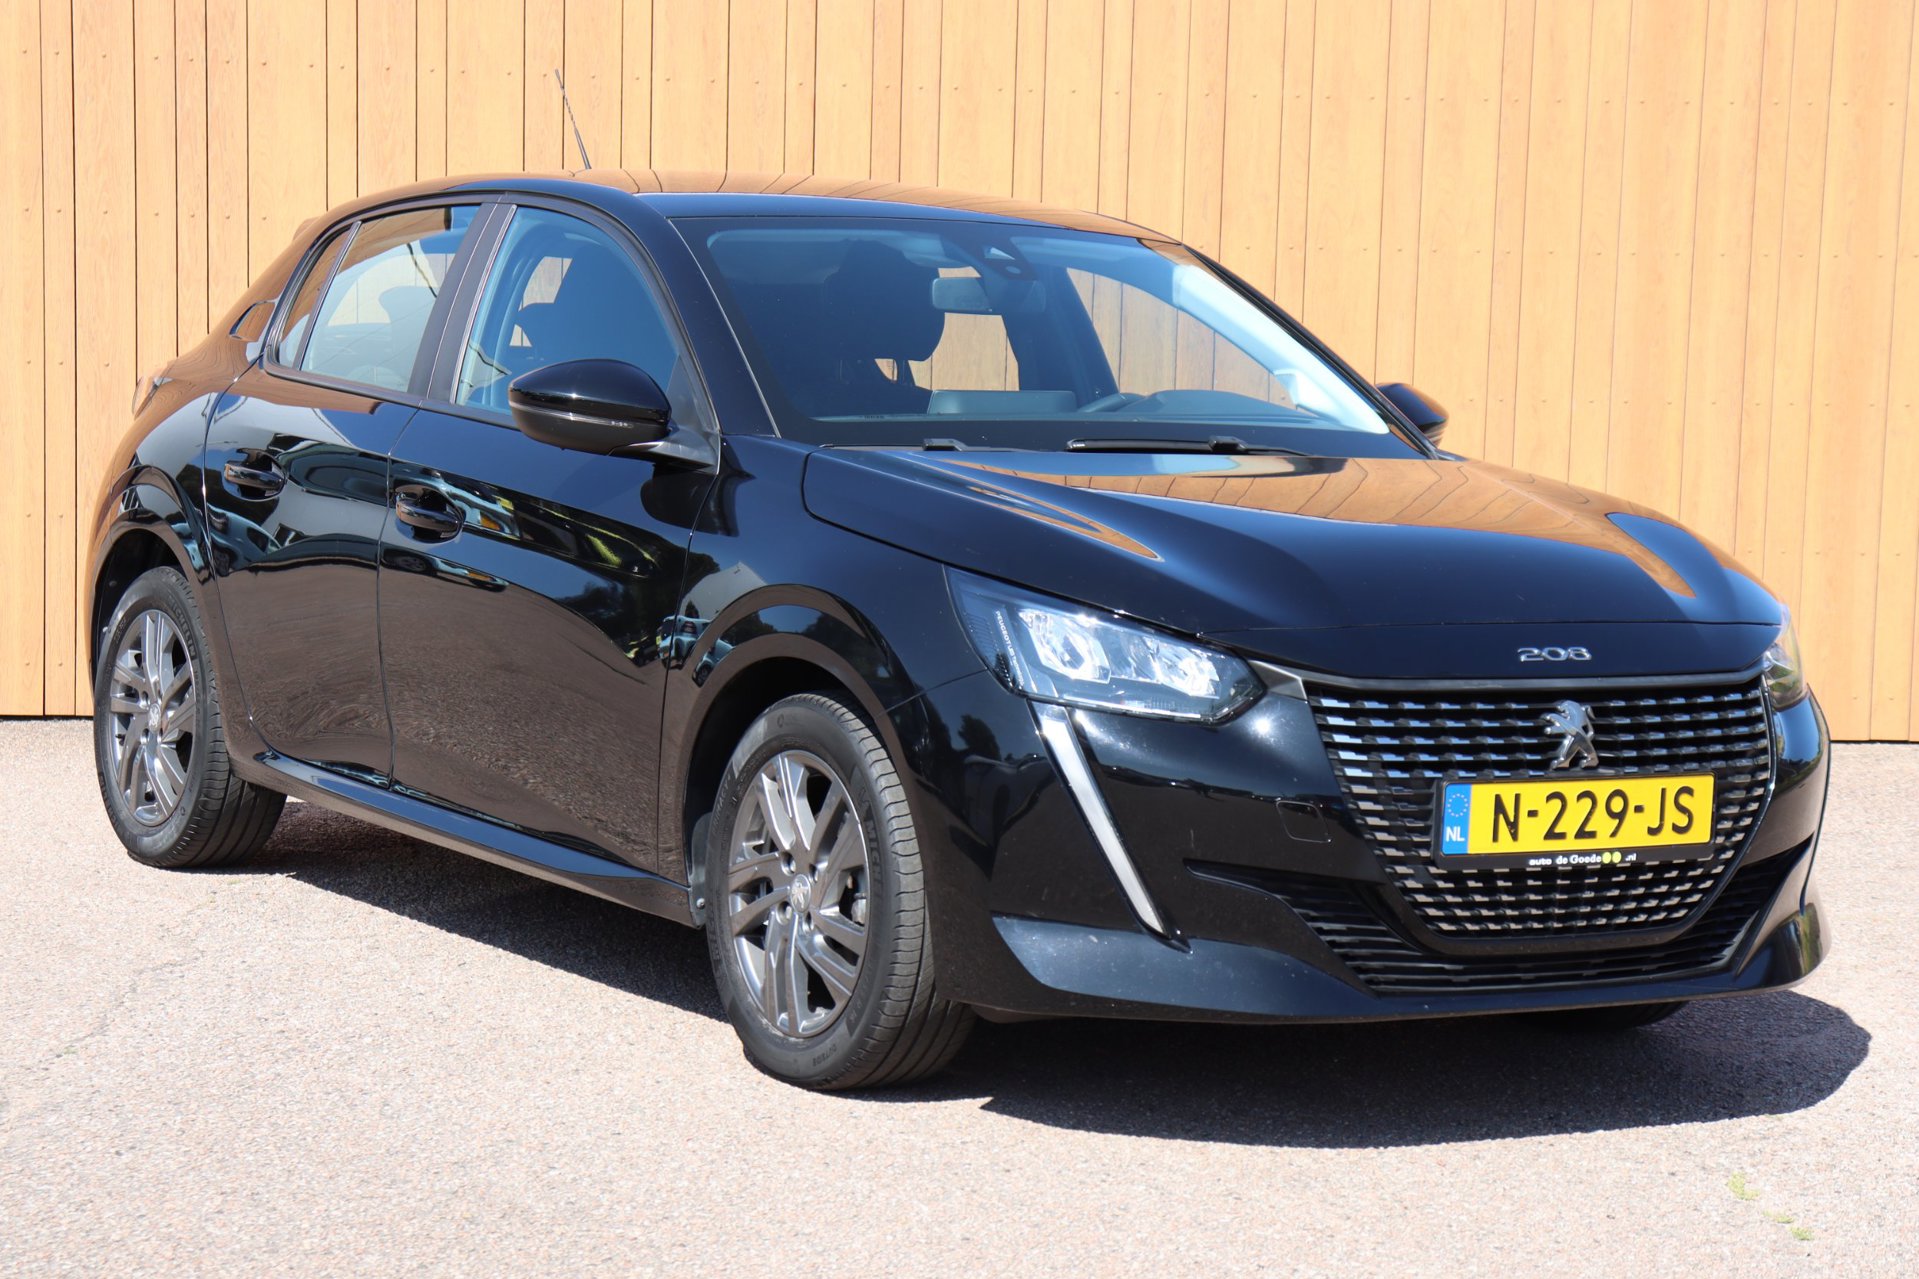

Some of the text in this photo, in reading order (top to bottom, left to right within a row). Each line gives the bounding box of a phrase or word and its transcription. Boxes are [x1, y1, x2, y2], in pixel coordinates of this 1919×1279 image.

[995, 610, 1012, 646] PEUGEOT
[1517, 646, 1592, 662] 208
[1492, 786, 1695, 843] N-229-JS
[1446, 826, 1465, 842] NL
[1529, 853, 1637, 866] auto de Goede .nl
